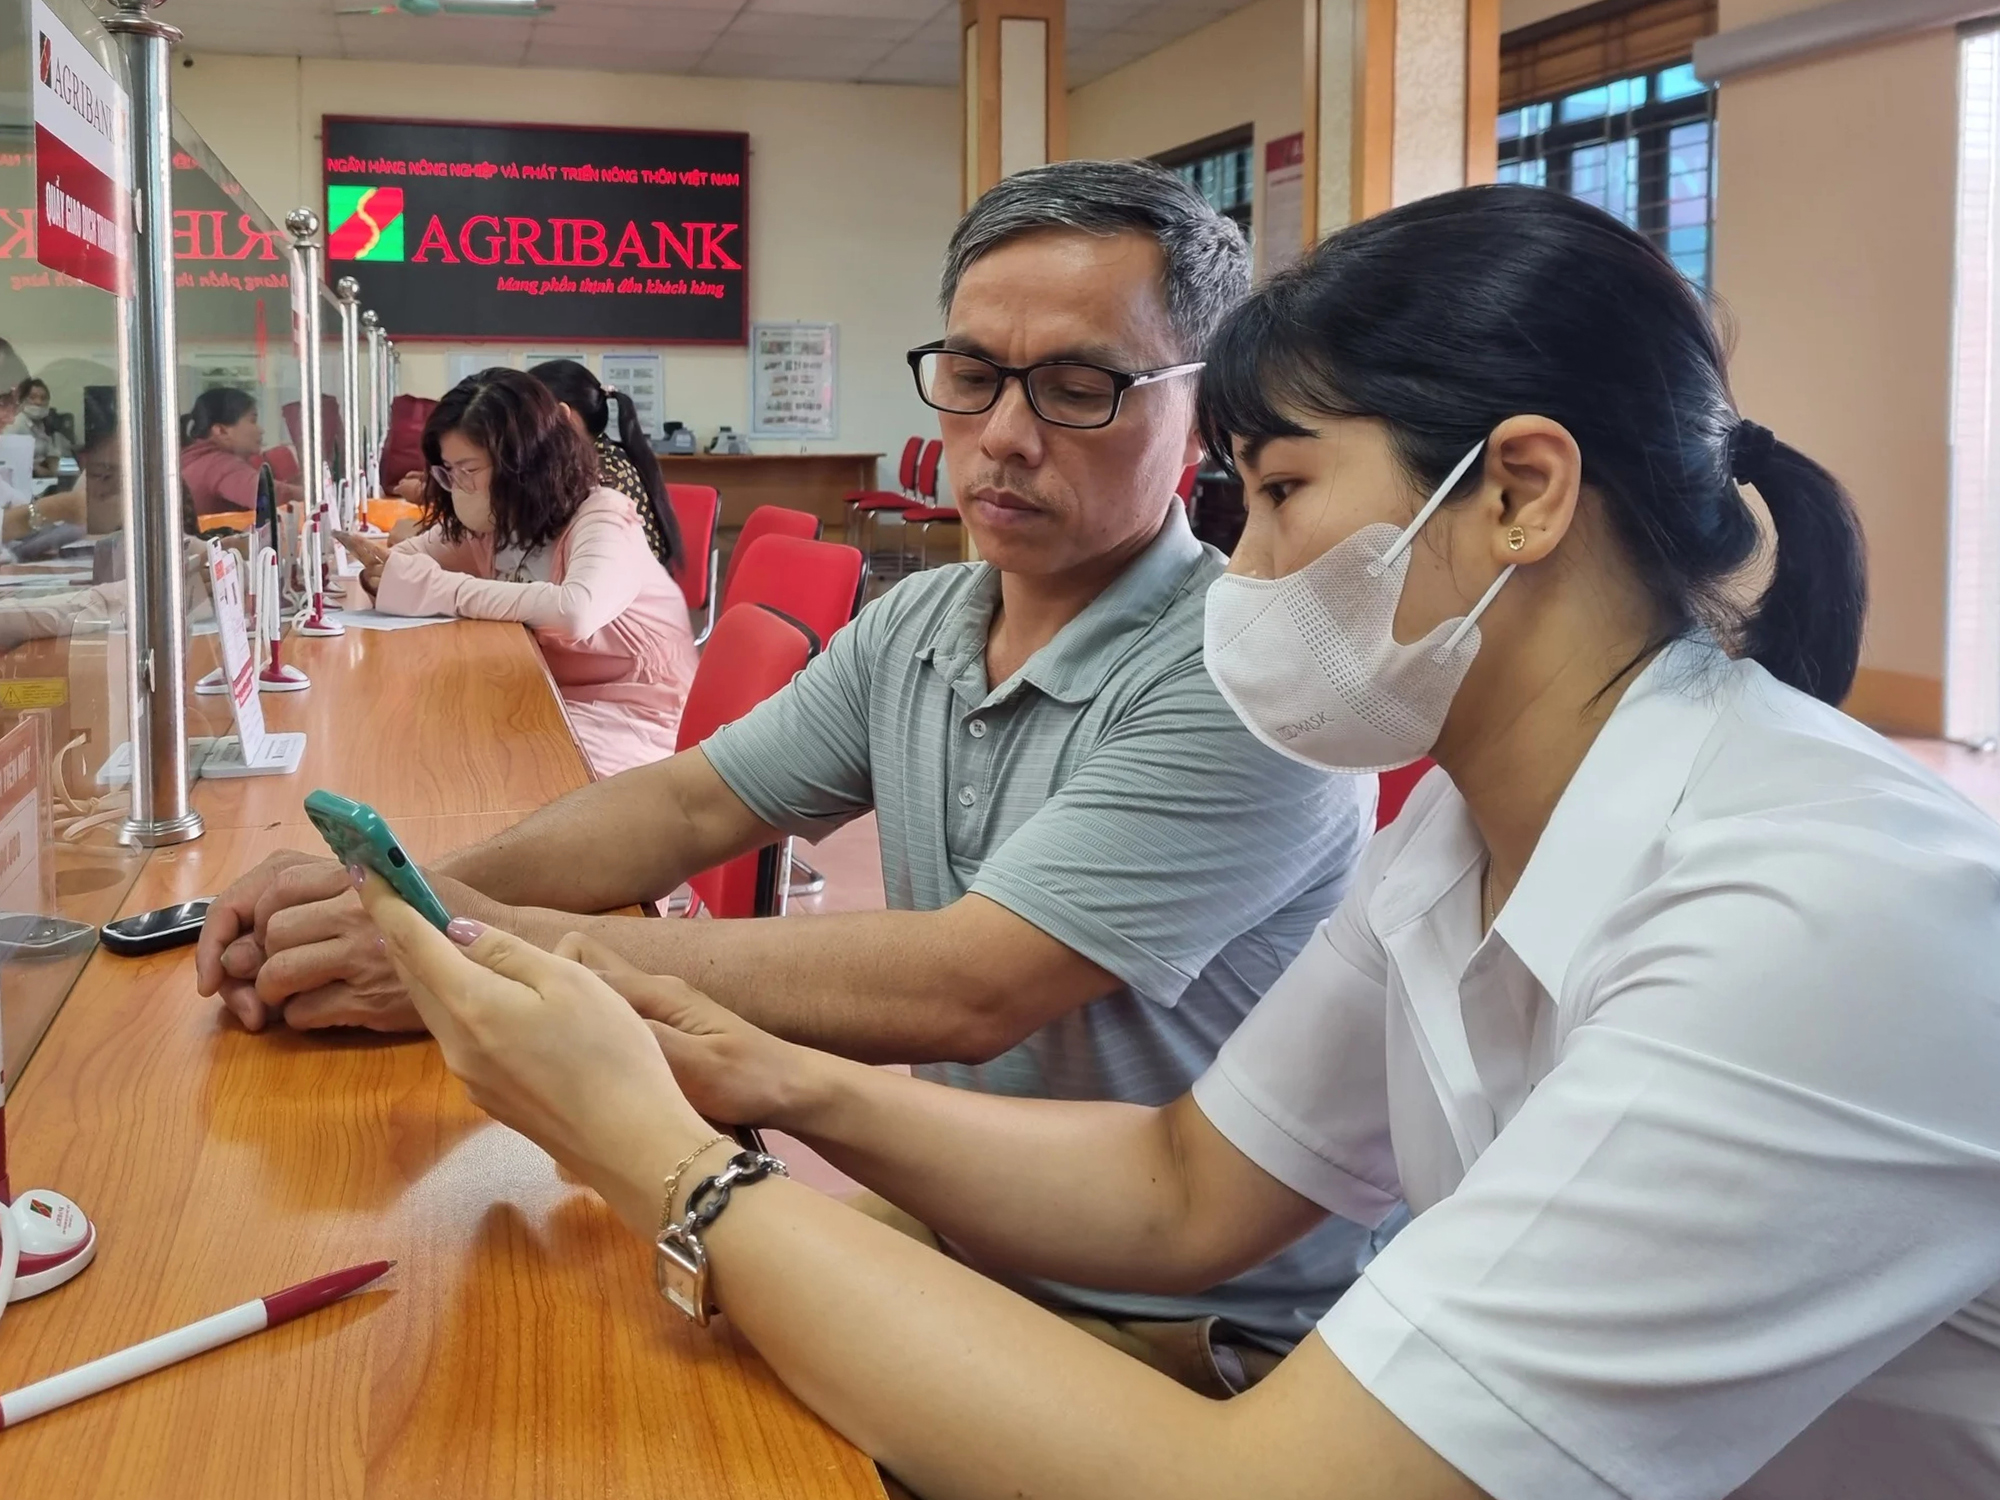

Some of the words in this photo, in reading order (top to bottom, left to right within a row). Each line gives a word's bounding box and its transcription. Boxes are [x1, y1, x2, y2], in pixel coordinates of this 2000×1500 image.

[54, 57, 115, 144] AGRIBANK
[326, 156, 366, 173] NGÂN
[367, 157, 406, 175] HÀNG
[408, 158, 448, 177] NÔNG
[449, 161, 498, 180] NGHIỆP
[501, 162, 520, 179] VÀ
[522, 163, 557, 180] PHÁT
[601, 165, 639, 184] NÔNG
[641, 167, 678, 185] THÔN
[678, 168, 709, 187] VIỆT
[711, 172, 740, 187] NAM
[411, 214, 742, 270] AGRIBANK
[496, 276, 538, 296] Mang
[579, 277, 615, 295] thịnh
[645, 279, 688, 295] khách
[689, 280, 725, 299] hàng
